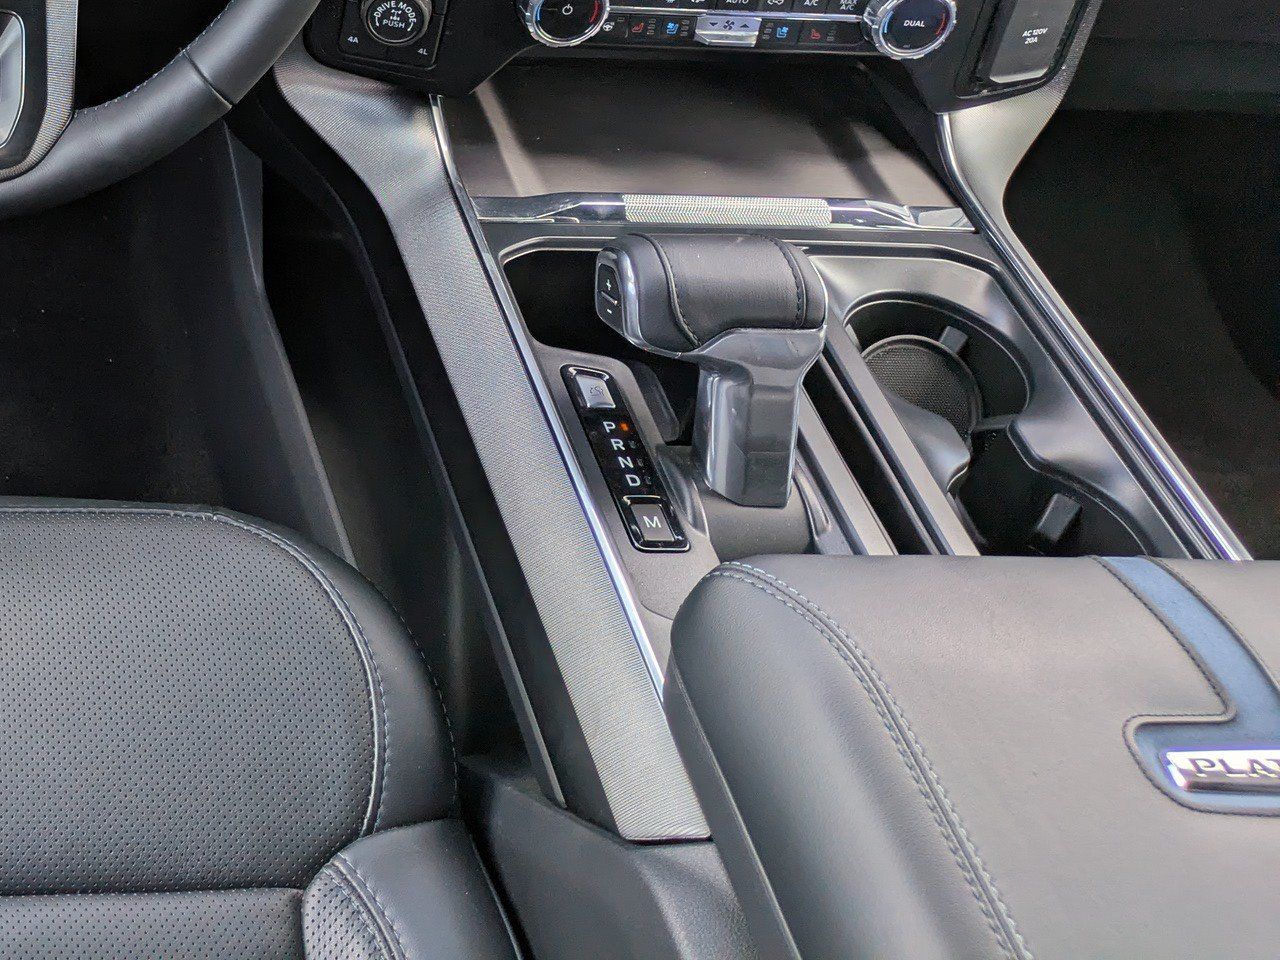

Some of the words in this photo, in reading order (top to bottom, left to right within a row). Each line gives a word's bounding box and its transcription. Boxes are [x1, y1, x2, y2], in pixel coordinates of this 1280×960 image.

[373, 0, 396, 18] DRIVE
[398, 2, 417, 23] MODE
[839, 3, 855, 11] A/C
[382, 18, 406, 29] PUSH
[903, 19, 925, 28] DUAL
[347, 35, 359, 44] 4A
[1024, 35, 1038, 44] 20A
[418, 47, 428, 56] 4L
[603, 421, 617, 433] P
[611, 438, 626, 451] R
[617, 456, 634, 468] N
[625, 474, 641, 487] D
[643, 515, 662, 528] M
